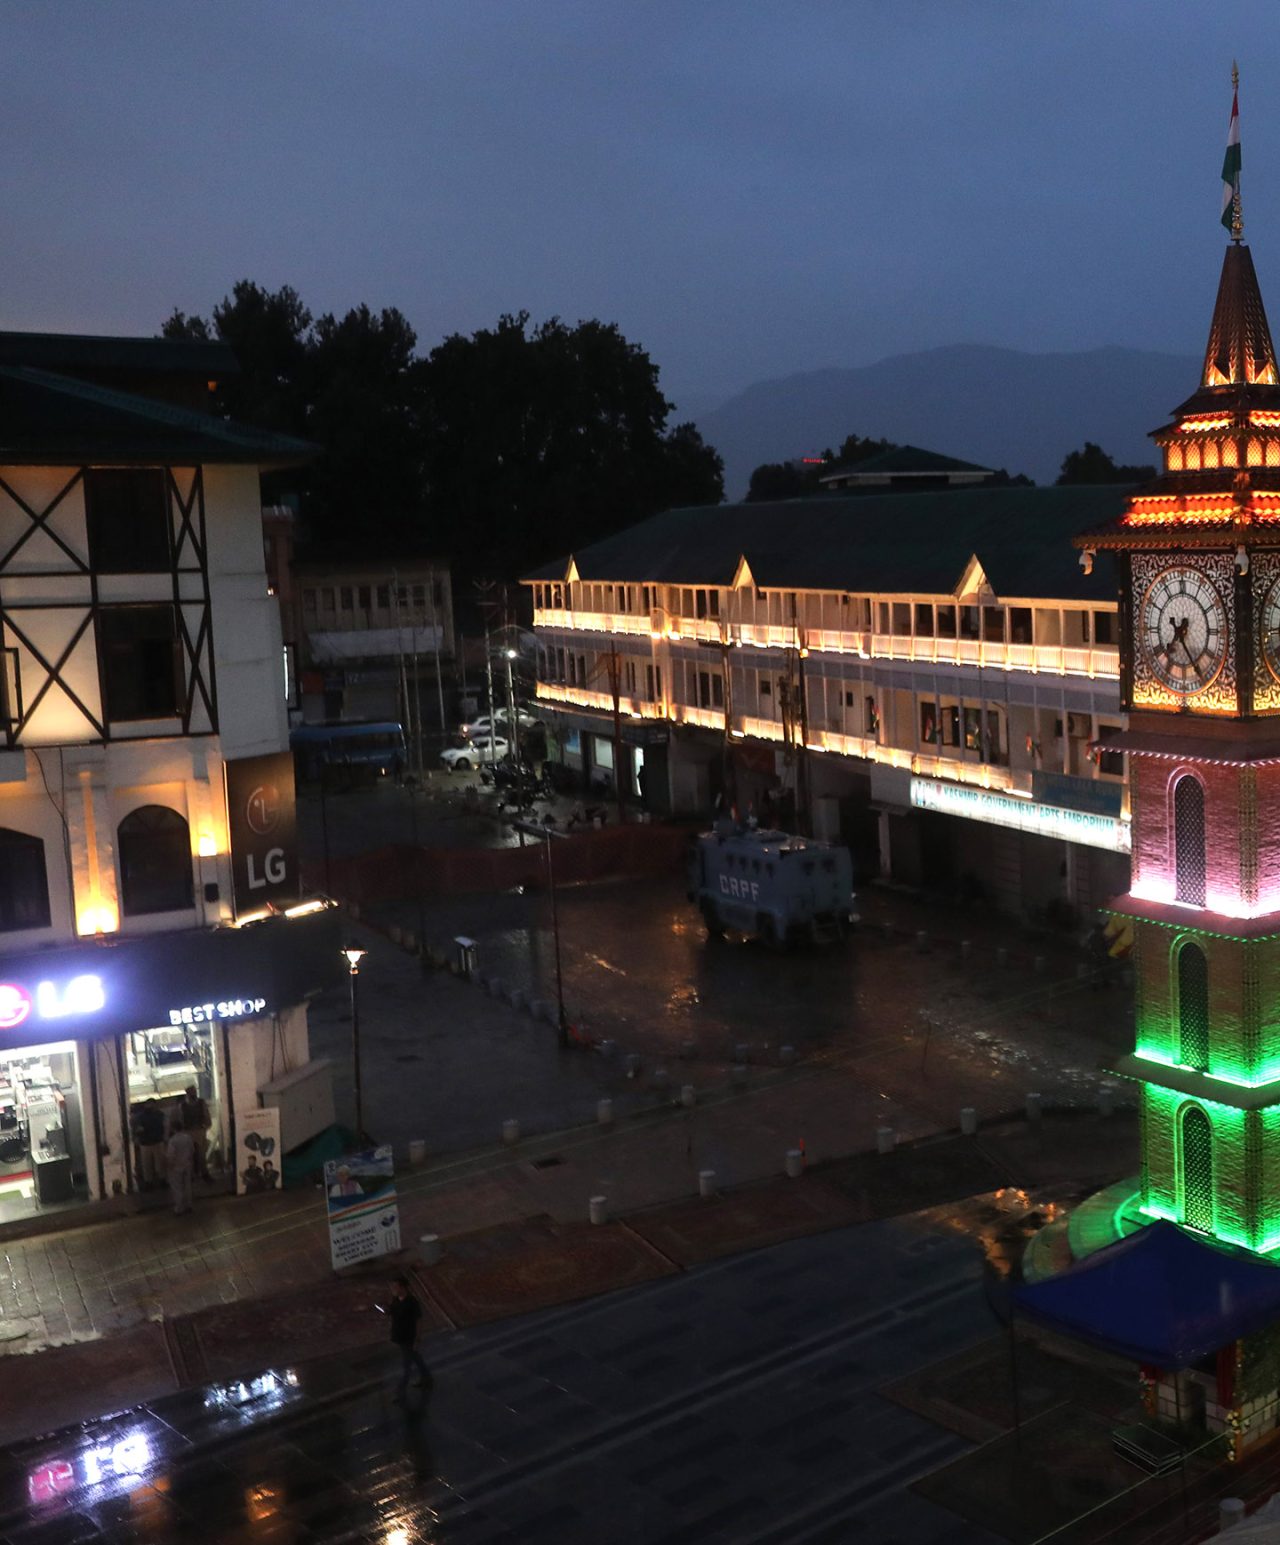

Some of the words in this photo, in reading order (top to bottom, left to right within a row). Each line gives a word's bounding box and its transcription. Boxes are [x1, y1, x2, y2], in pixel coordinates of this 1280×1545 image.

[981, 794, 1037, 818] GOVERNMENT
[1039, 804, 1060, 824] ARTS
[1063, 810, 1114, 831] EMPORIUM
[246, 847, 287, 890] LG
[719, 873, 760, 902] CRPF
[37, 974, 105, 1018] LG
[168, 1003, 216, 1026] BEST
[216, 997, 267, 1019] SHOP
[333, 1226, 376, 1246] WELCOME
